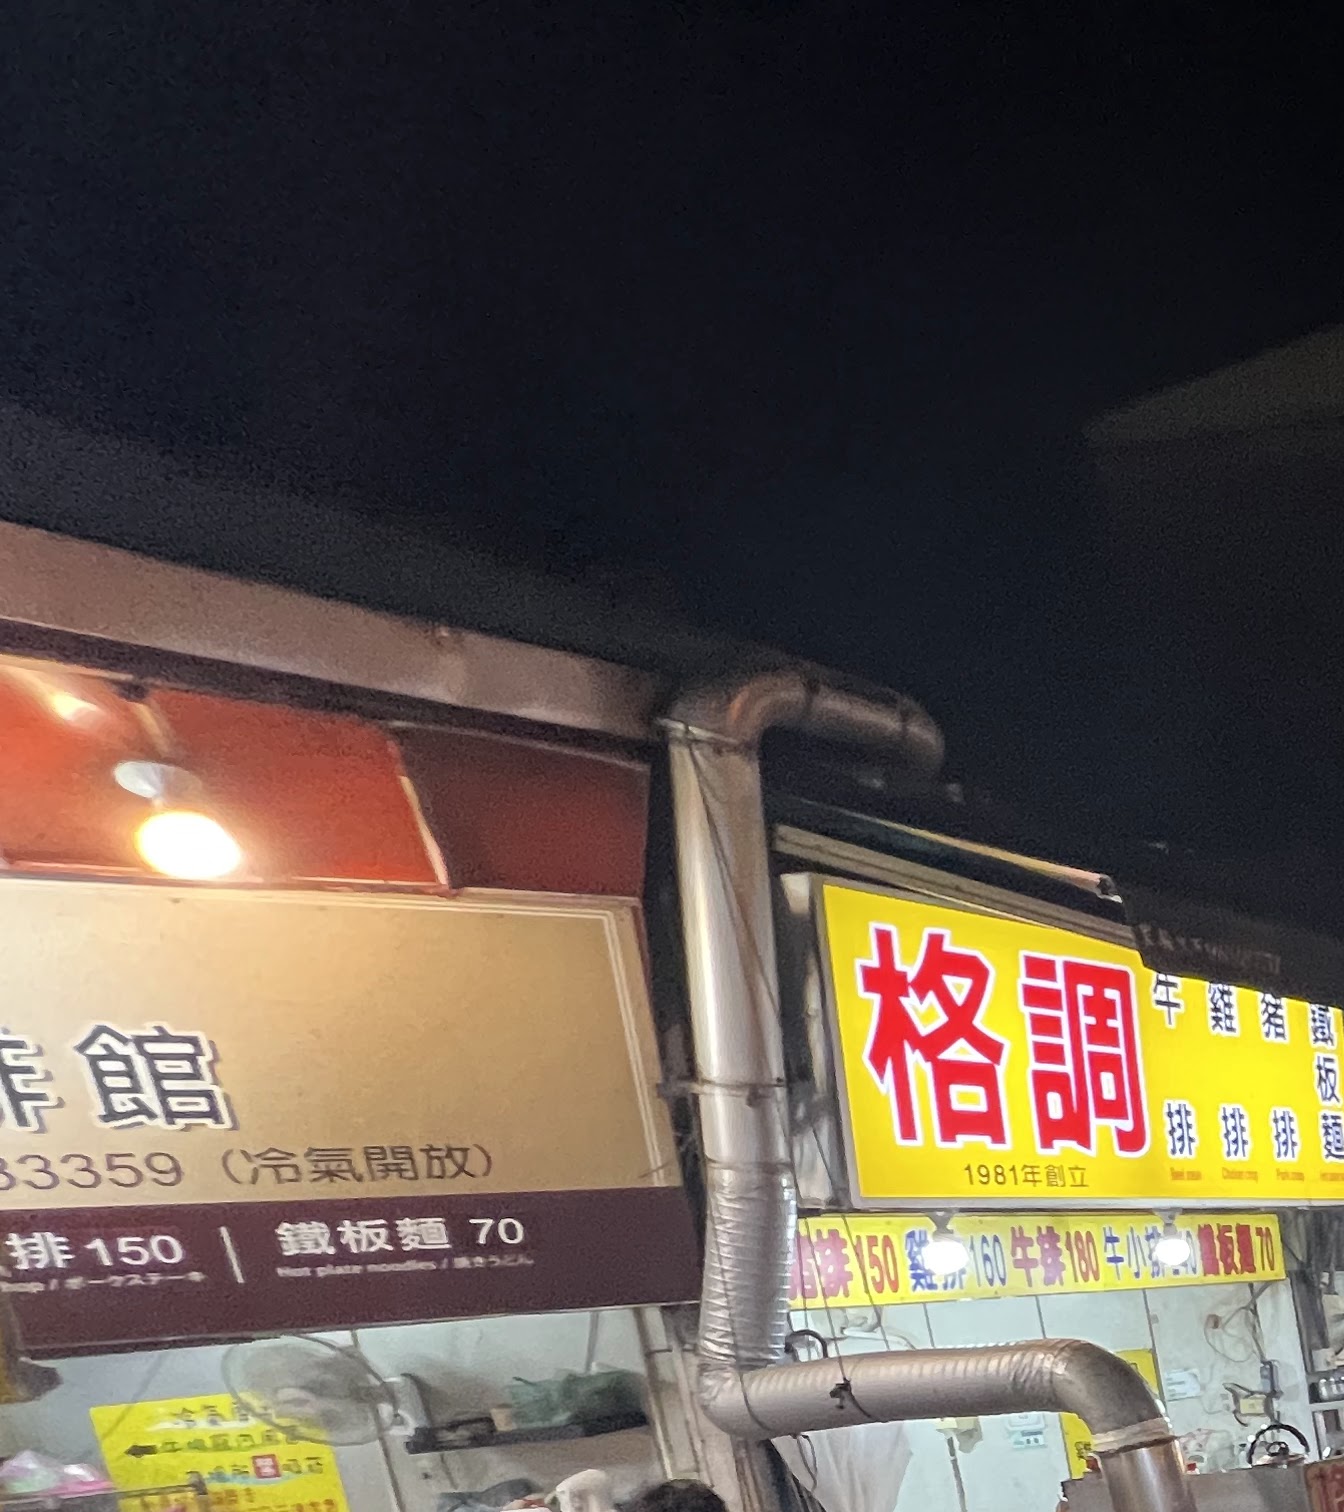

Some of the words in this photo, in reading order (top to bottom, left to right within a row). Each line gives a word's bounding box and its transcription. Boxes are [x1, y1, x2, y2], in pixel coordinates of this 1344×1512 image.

[857, 924, 1149, 1156] 格調
[963, 1163, 1090, 1190] 1981年創立
[85, 1234, 183, 1267] 150
[276, 1217, 451, 1255] 鐵板麵
[469, 1217, 524, 1245] 70
